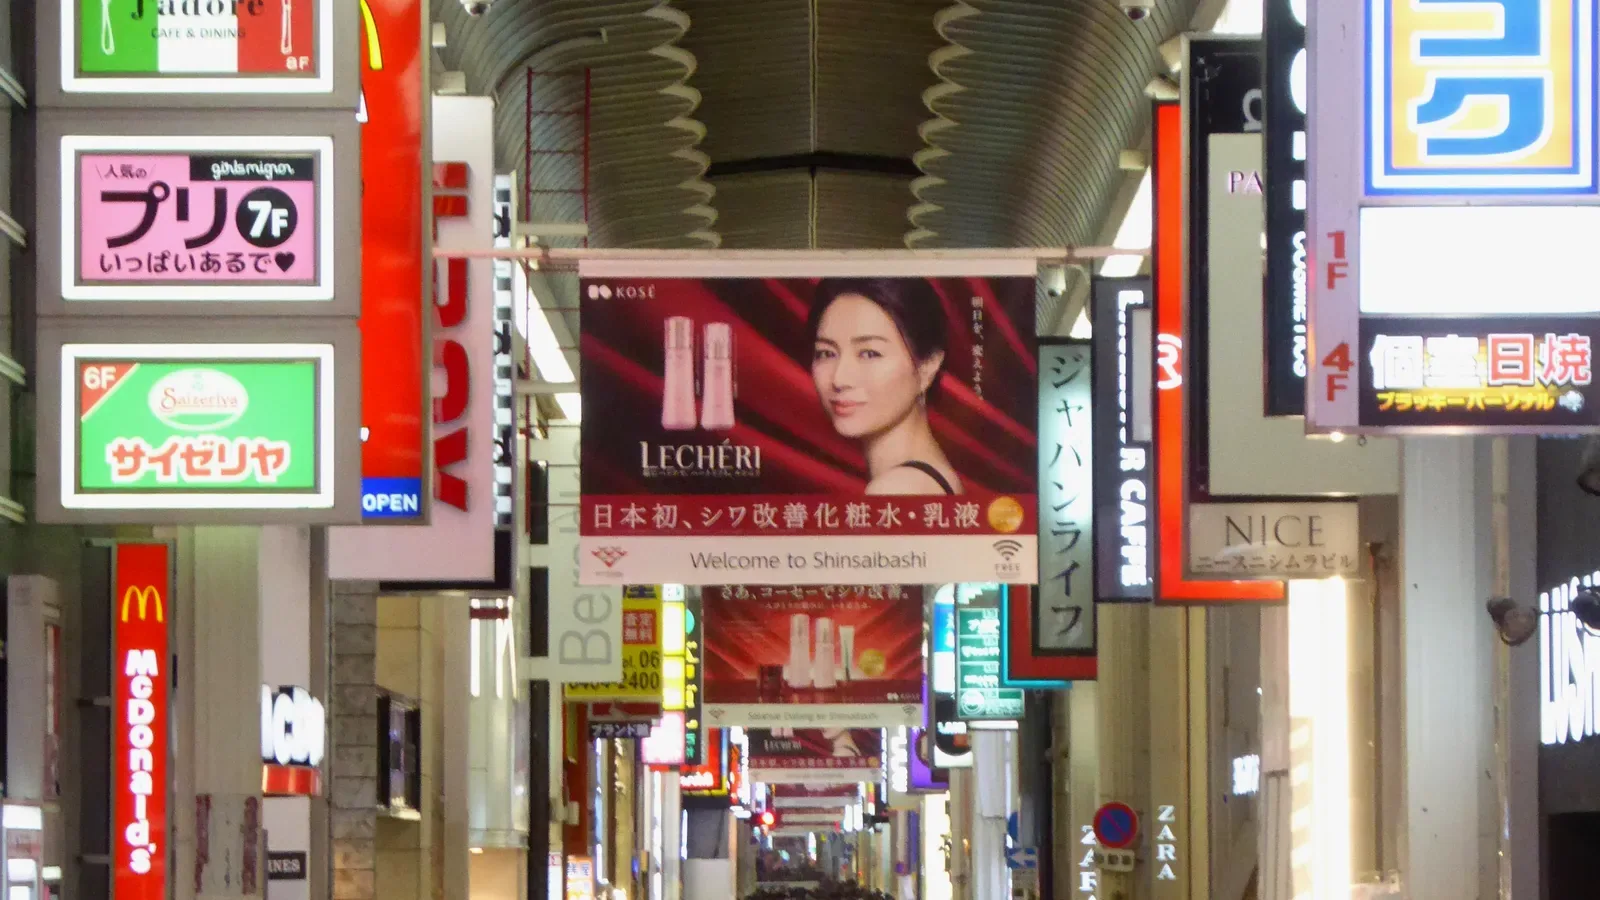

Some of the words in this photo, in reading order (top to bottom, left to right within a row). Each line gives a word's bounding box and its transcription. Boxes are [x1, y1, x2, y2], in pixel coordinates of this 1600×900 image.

[130, 0, 265, 21] Jadore
[151, 28, 181, 38] CAFE
[187, 28, 196, 38] &
[200, 28, 246, 39] DINING
[104, 164, 148, 179] 人気の
[101, 181, 227, 249] プリ
[248, 200, 289, 239] 7F
[83, 366, 116, 390] 6F
[160, 387, 238, 412] Saizeriya
[109, 437, 288, 480] サイゼリヤ
[640, 438, 760, 469] LECHÉRI
[362, 493, 418, 512] OPEN
[594, 502, 981, 530] 日本初、シワ改善化粧水・乳液
[1224, 514, 1324, 547] NICE
[690, 551, 780, 569] Welcome
[787, 554, 807, 569] to
[813, 550, 927, 569] Shinsaibashi
[639, 649, 661, 668] 06
[125, 649, 158, 875] McDonald's
[1157, 805, 1177, 880] ZARA
